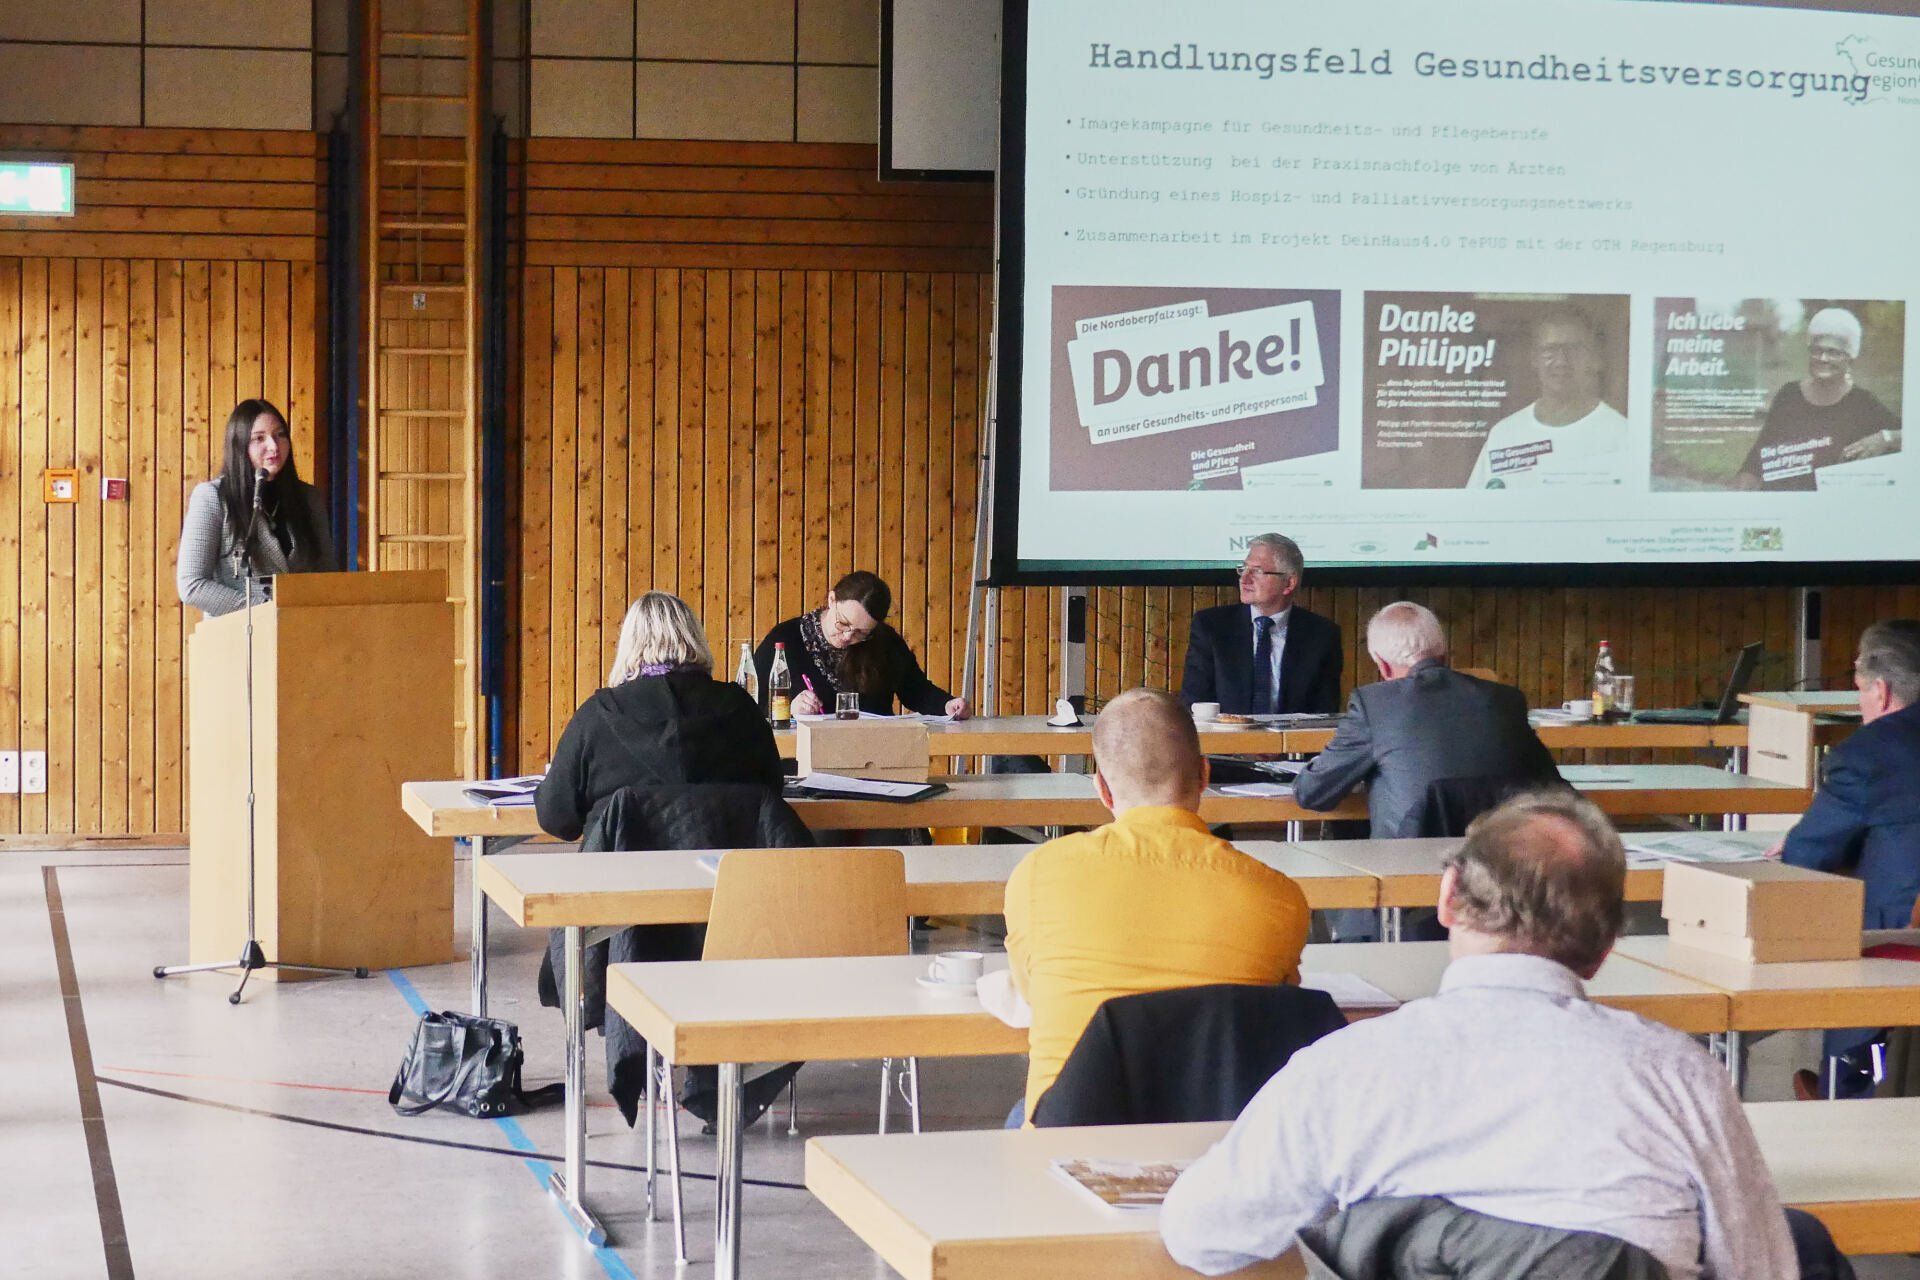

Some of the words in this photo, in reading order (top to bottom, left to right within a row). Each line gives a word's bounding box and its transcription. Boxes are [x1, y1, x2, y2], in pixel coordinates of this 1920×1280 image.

[1088, 43, 1393, 79] Handlungsfeld
[1414, 50, 1871, 101] Gesundheitsversorgung
[1866, 52, 1920, 68] Gesun
[1079, 118, 1213, 134] Imagekampagne
[1223, 119, 1251, 133] für
[1262, 120, 1384, 137] Gesundheits-
[1392, 124, 1421, 137] und
[1432, 124, 1548, 142] Pflegeberufe
[1077, 152, 1213, 170] Unterstützung
[1231, 155, 1263, 168] bei
[1271, 156, 1302, 169] der
[1312, 157, 1461, 176] Praxisnachfolge
[1469, 163, 1498, 174] von
[1076, 186, 1160, 204] Gründung
[1169, 189, 1220, 202] eines
[1231, 190, 1301, 206] Hospiz-
[1312, 192, 1342, 205] und
[1352, 192, 1632, 210] Palliativversorgungsnetzwerks
[1076, 229, 1222, 244] Zusammenarbeit
[1231, 232, 1252, 244] im
[1261, 232, 1332, 248] Projekt
[1515, 237, 1546, 250] mit
[1554, 238, 1584, 251] der
[1631, 240, 1725, 254] Regensburg
[1081, 321, 1098, 333] Die
[1100, 308, 1176, 331] Nordoberpfalz
[1177, 305, 1204, 319] sagt:
[1378, 303, 1476, 333] Danke
[1667, 311, 1697, 330] Ich
[1377, 337, 1497, 374] Philipp!
[1666, 334, 1724, 353] meine
[1093, 318, 1301, 406] Danke!
[1665, 357, 1730, 376] Arbeit.
[1097, 427, 1111, 437] an
[1112, 421, 1142, 434] unser
[1143, 410, 1211, 430] Gesundheits-
[1212, 404, 1231, 417] und
[1233, 391, 1308, 415] Pflegepersonal
[1191, 450, 1206, 461] Die
[1206, 441, 1256, 458] Gesundheit
[1192, 459, 1210, 470] und
[1211, 456, 1240, 470] Pflege
[1761, 447, 1777, 458] Die
